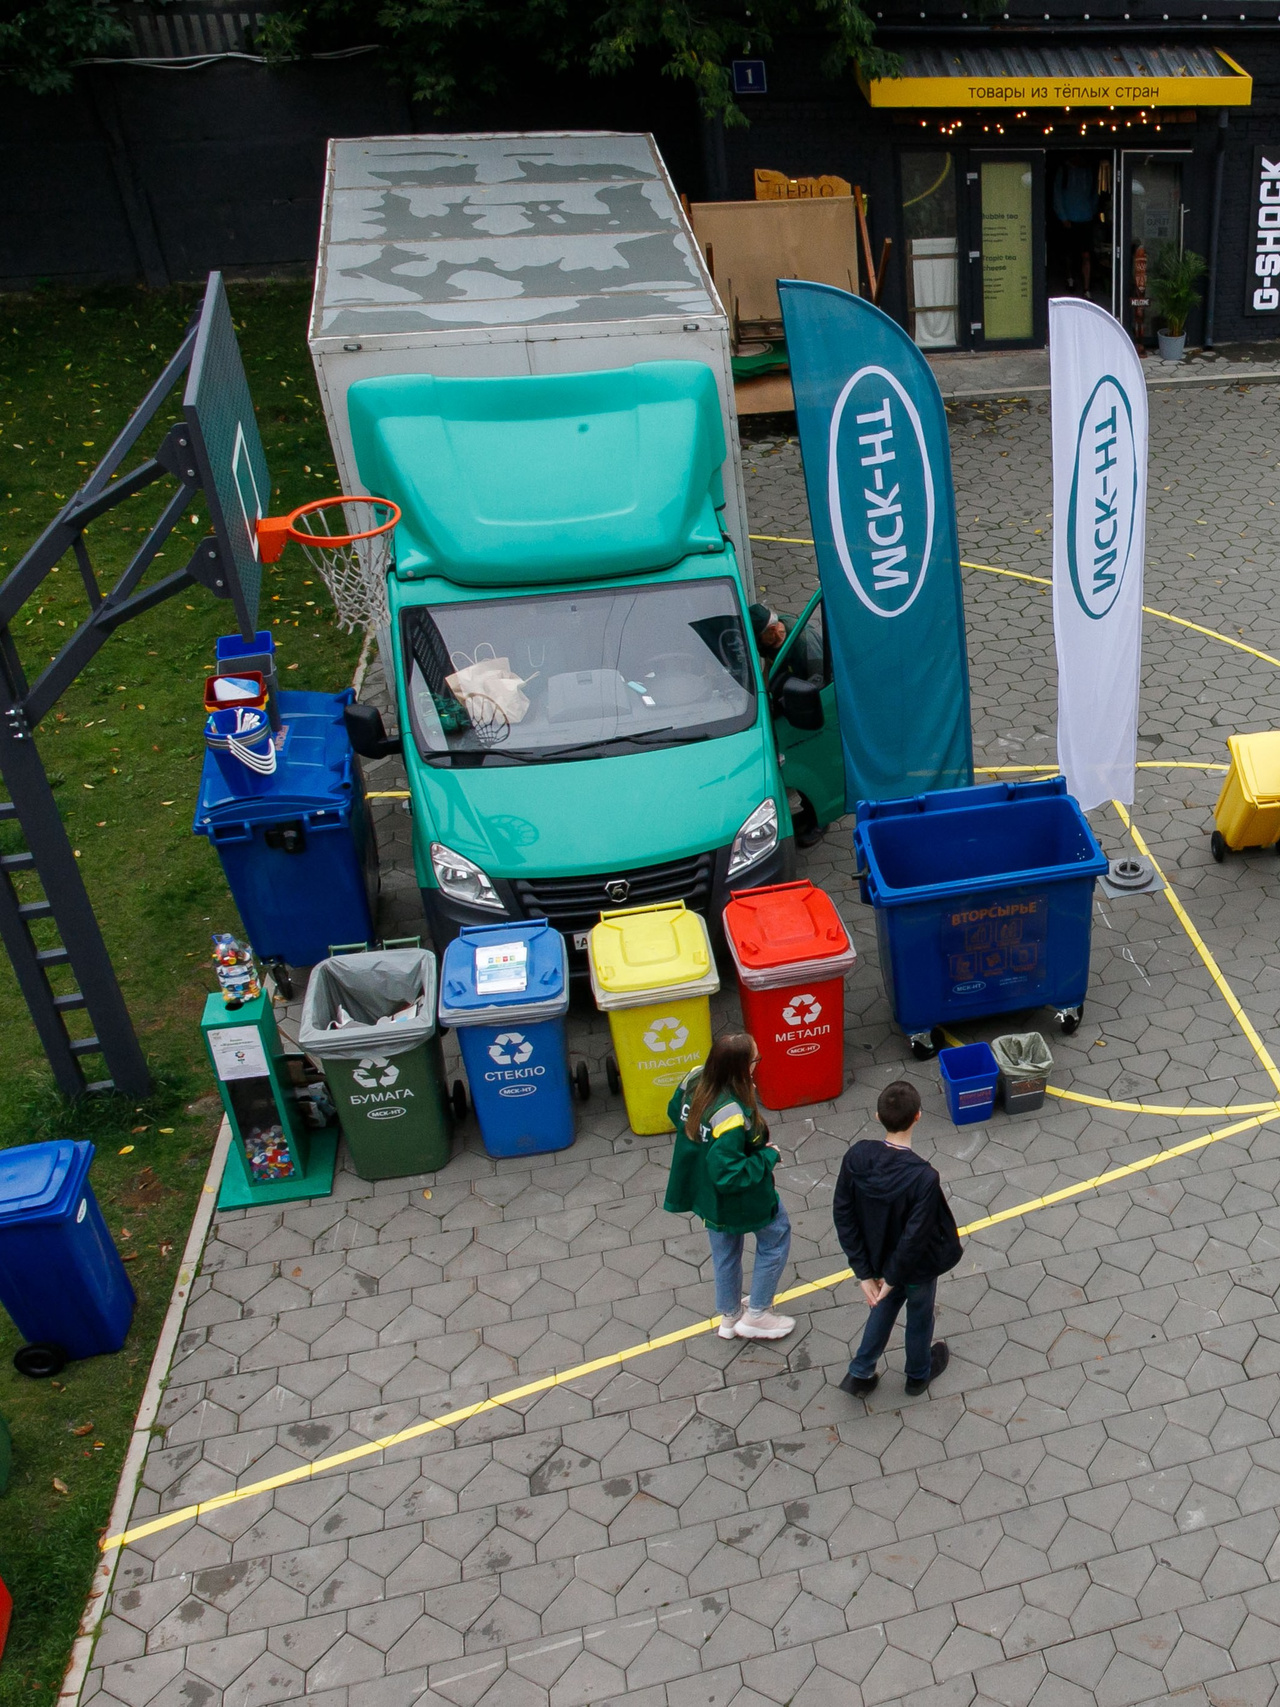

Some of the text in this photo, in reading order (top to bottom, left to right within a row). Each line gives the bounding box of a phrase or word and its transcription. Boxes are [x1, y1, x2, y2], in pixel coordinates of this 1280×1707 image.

[745, 68, 753, 85] 1
[968, 83, 1159, 101] товары из тёплых стран
[951, 901, 1037, 926] ВТОРСЫРЬЕ
[775, 1024, 831, 1043] МЕТАЛЛ
[638, 1051, 701, 1070] ПЛАСТИК
[484, 1065, 546, 1082] СТЕКЛО
[350, 1088, 415, 1105] БУМАГА
